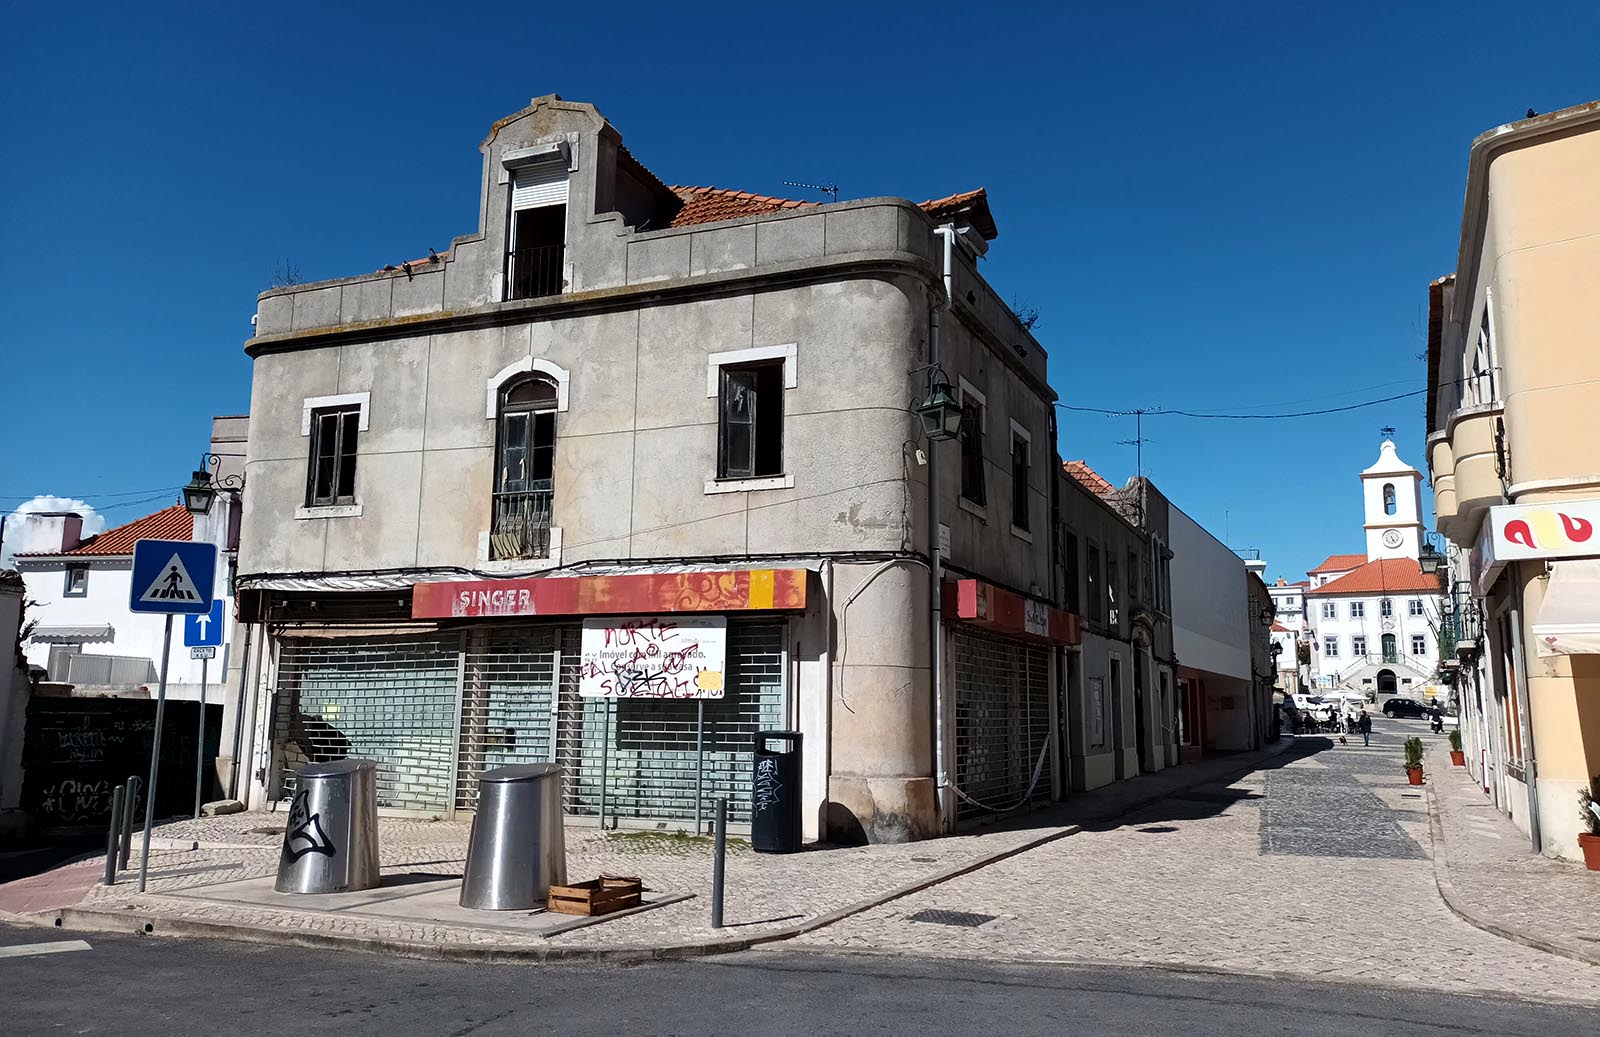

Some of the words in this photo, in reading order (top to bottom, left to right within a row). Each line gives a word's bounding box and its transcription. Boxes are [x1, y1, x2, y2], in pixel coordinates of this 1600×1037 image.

[460, 589, 530, 608] SINGER
[604, 618, 679, 648] MORTE
[599, 649, 627, 659] Imóvel
